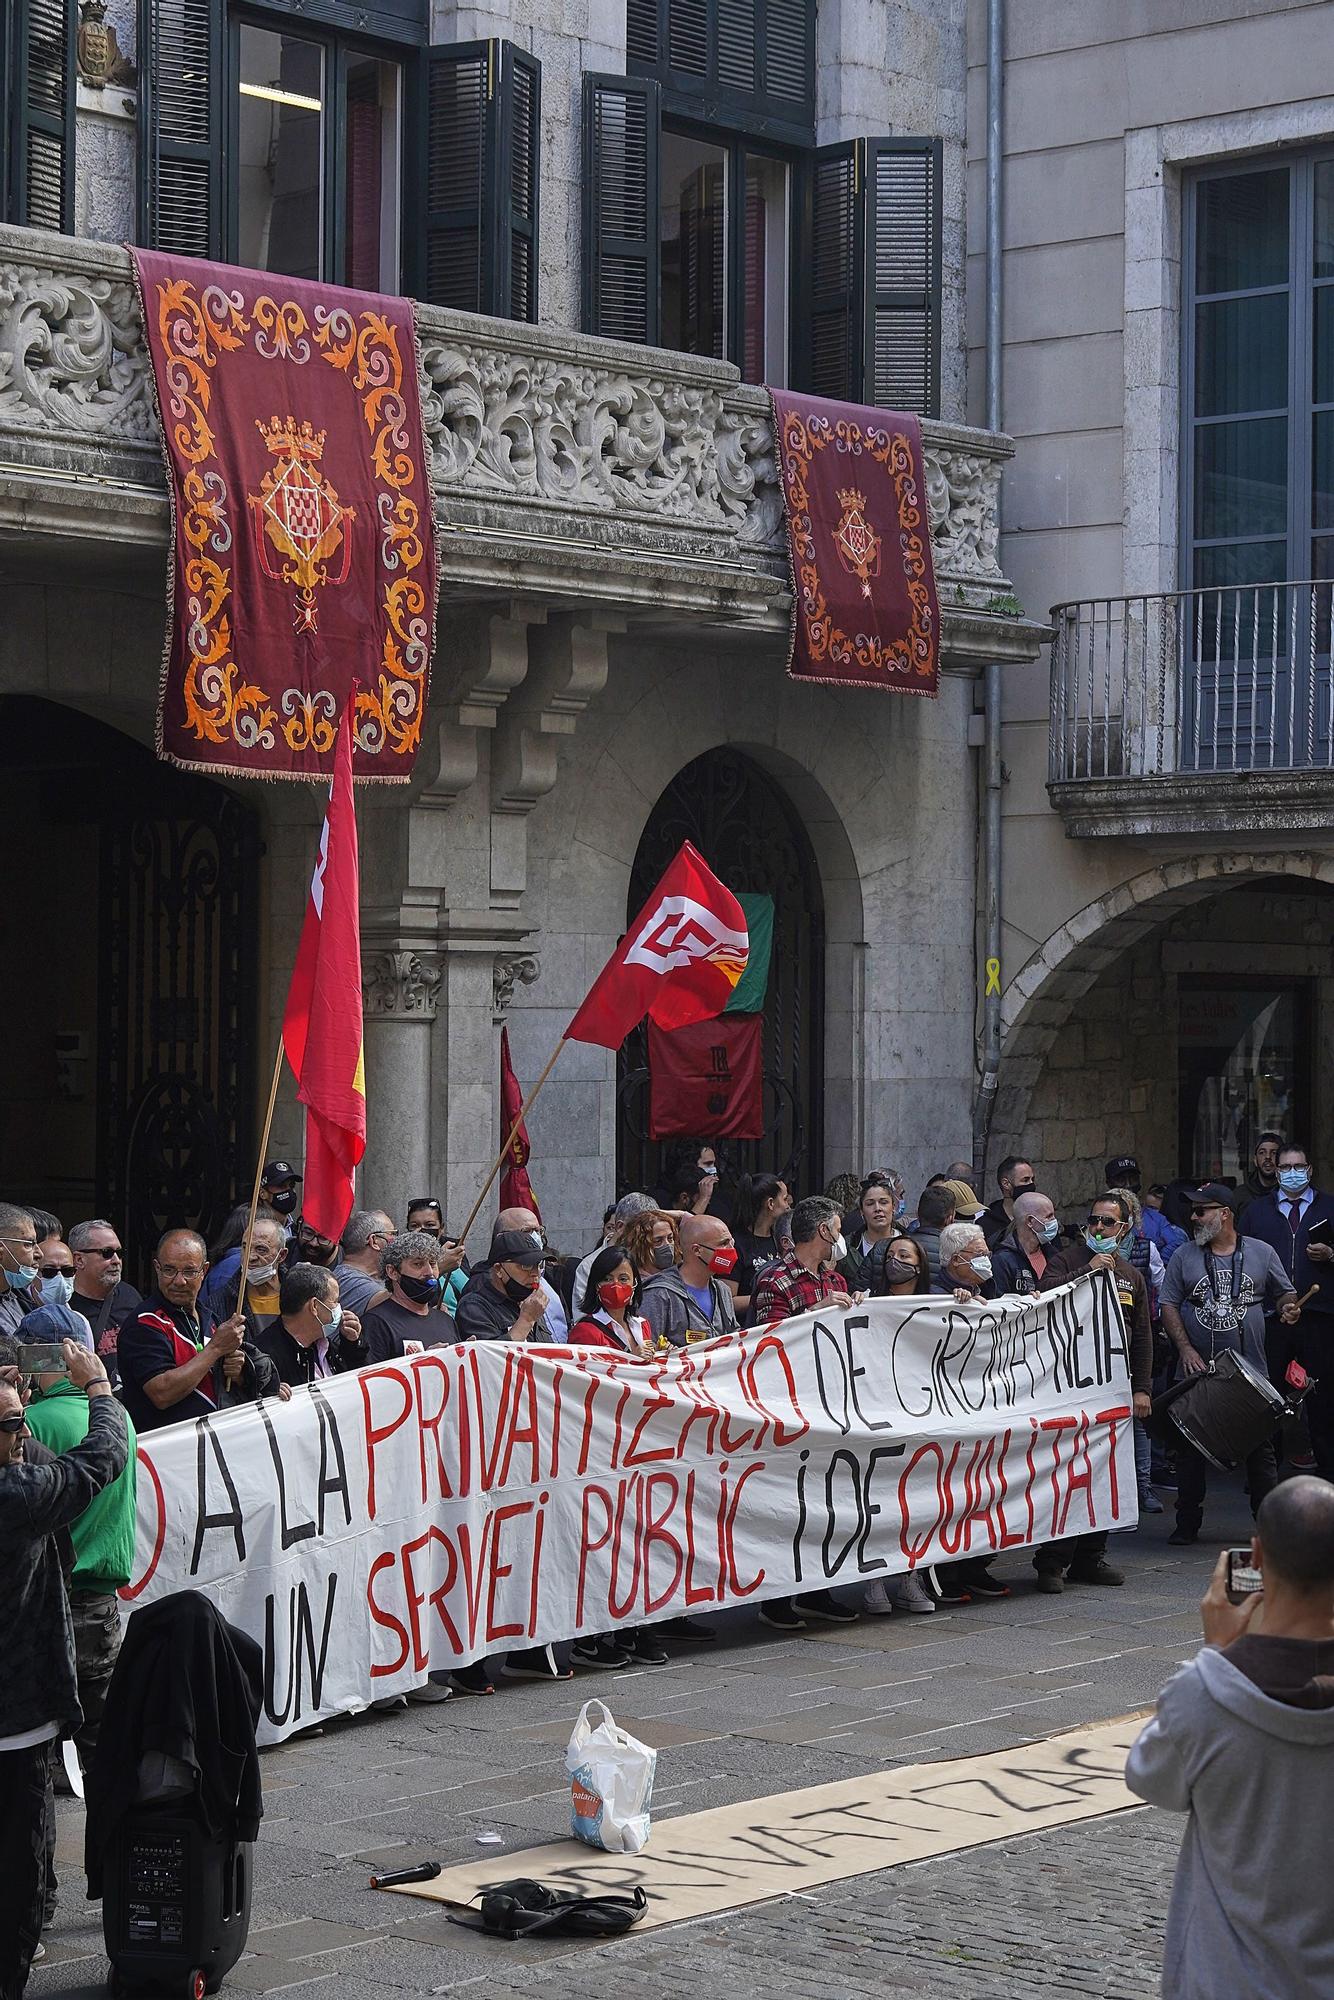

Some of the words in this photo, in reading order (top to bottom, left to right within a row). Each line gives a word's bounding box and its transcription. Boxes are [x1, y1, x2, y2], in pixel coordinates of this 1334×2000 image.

[191, 1414, 246, 1576] A
[256, 1383, 351, 1550] LA
[812, 1316, 892, 1434] DE
[264, 1572, 337, 1726] UN
[822, 1443, 906, 1578] DE
